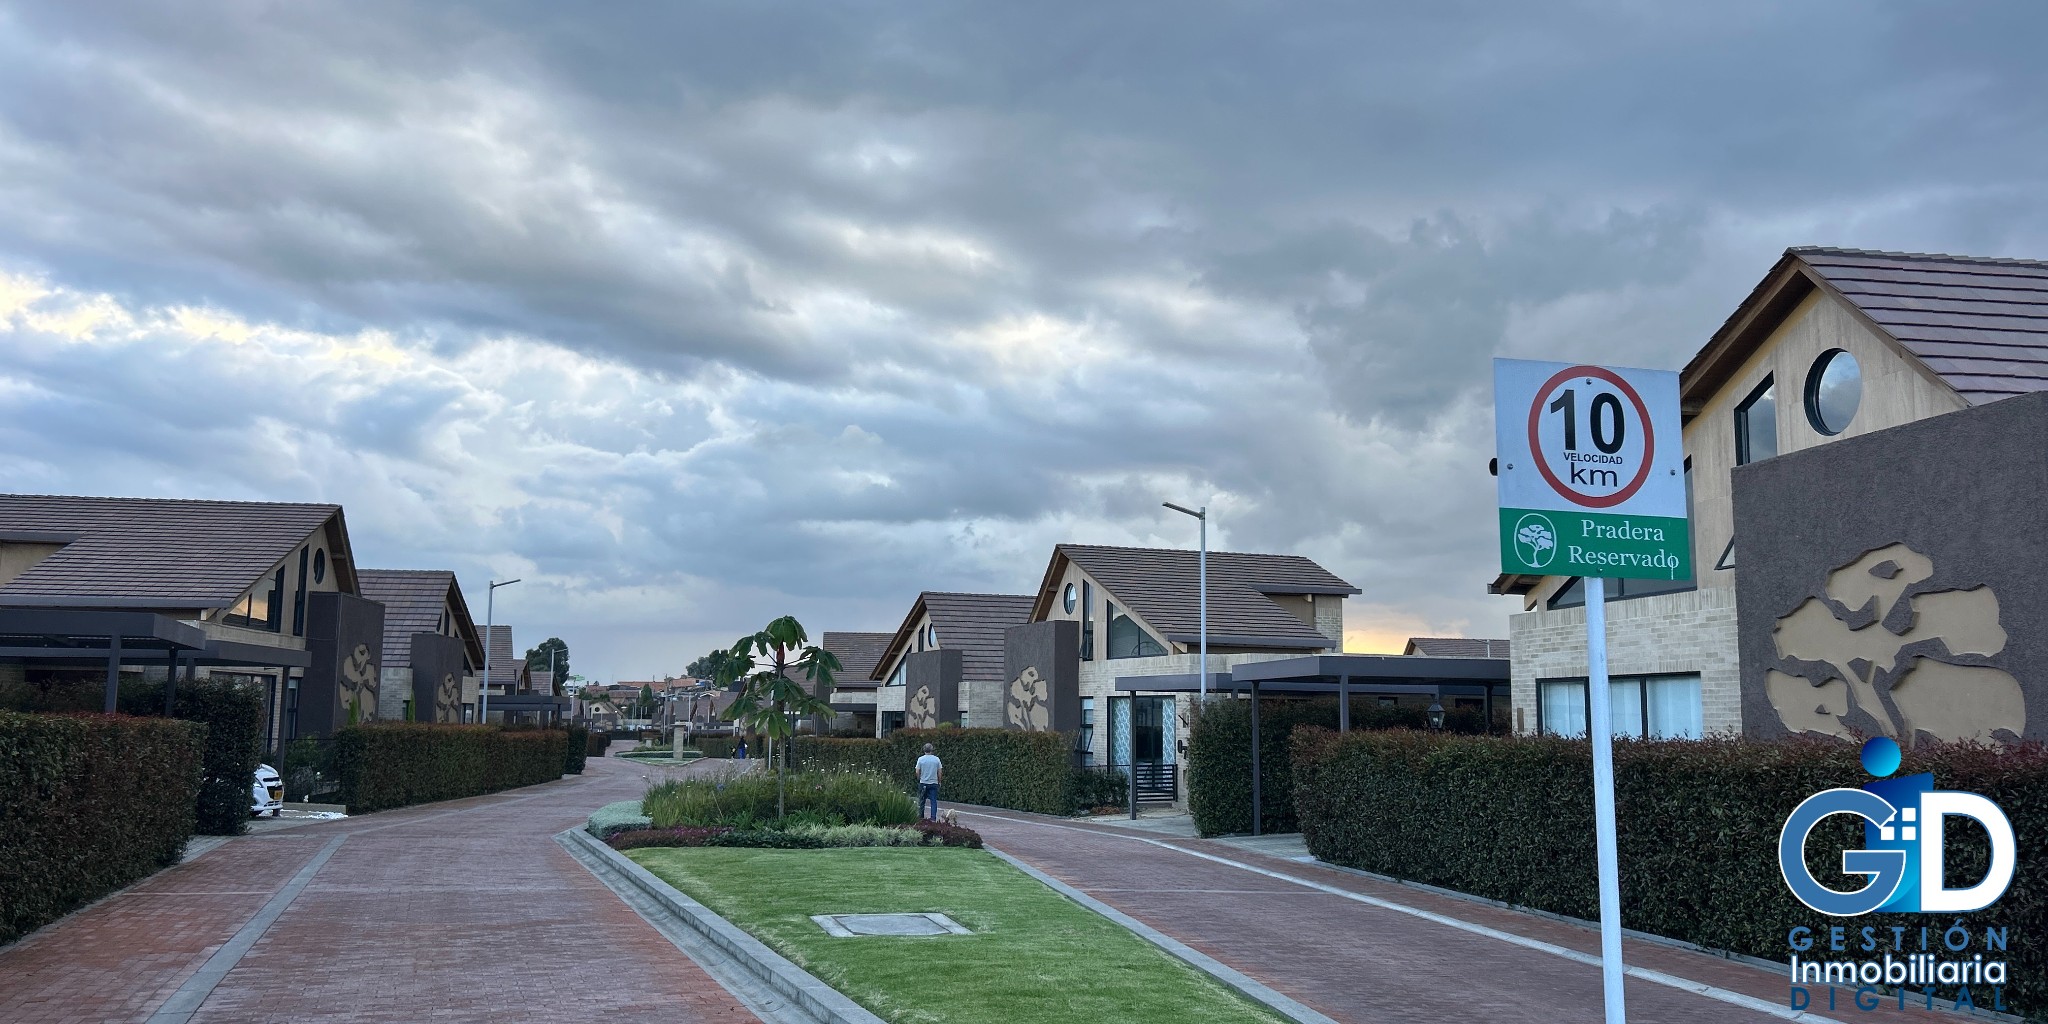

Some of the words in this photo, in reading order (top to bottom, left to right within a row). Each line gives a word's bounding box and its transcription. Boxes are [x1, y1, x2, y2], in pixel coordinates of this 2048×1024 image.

[1550, 389, 1625, 454] 10
[1563, 452, 1623, 465] VELOCIDAD
[1570, 462, 1618, 487] km
[1581, 520, 1665, 542] Pradera
[1568, 545, 1680, 569] Reservado
